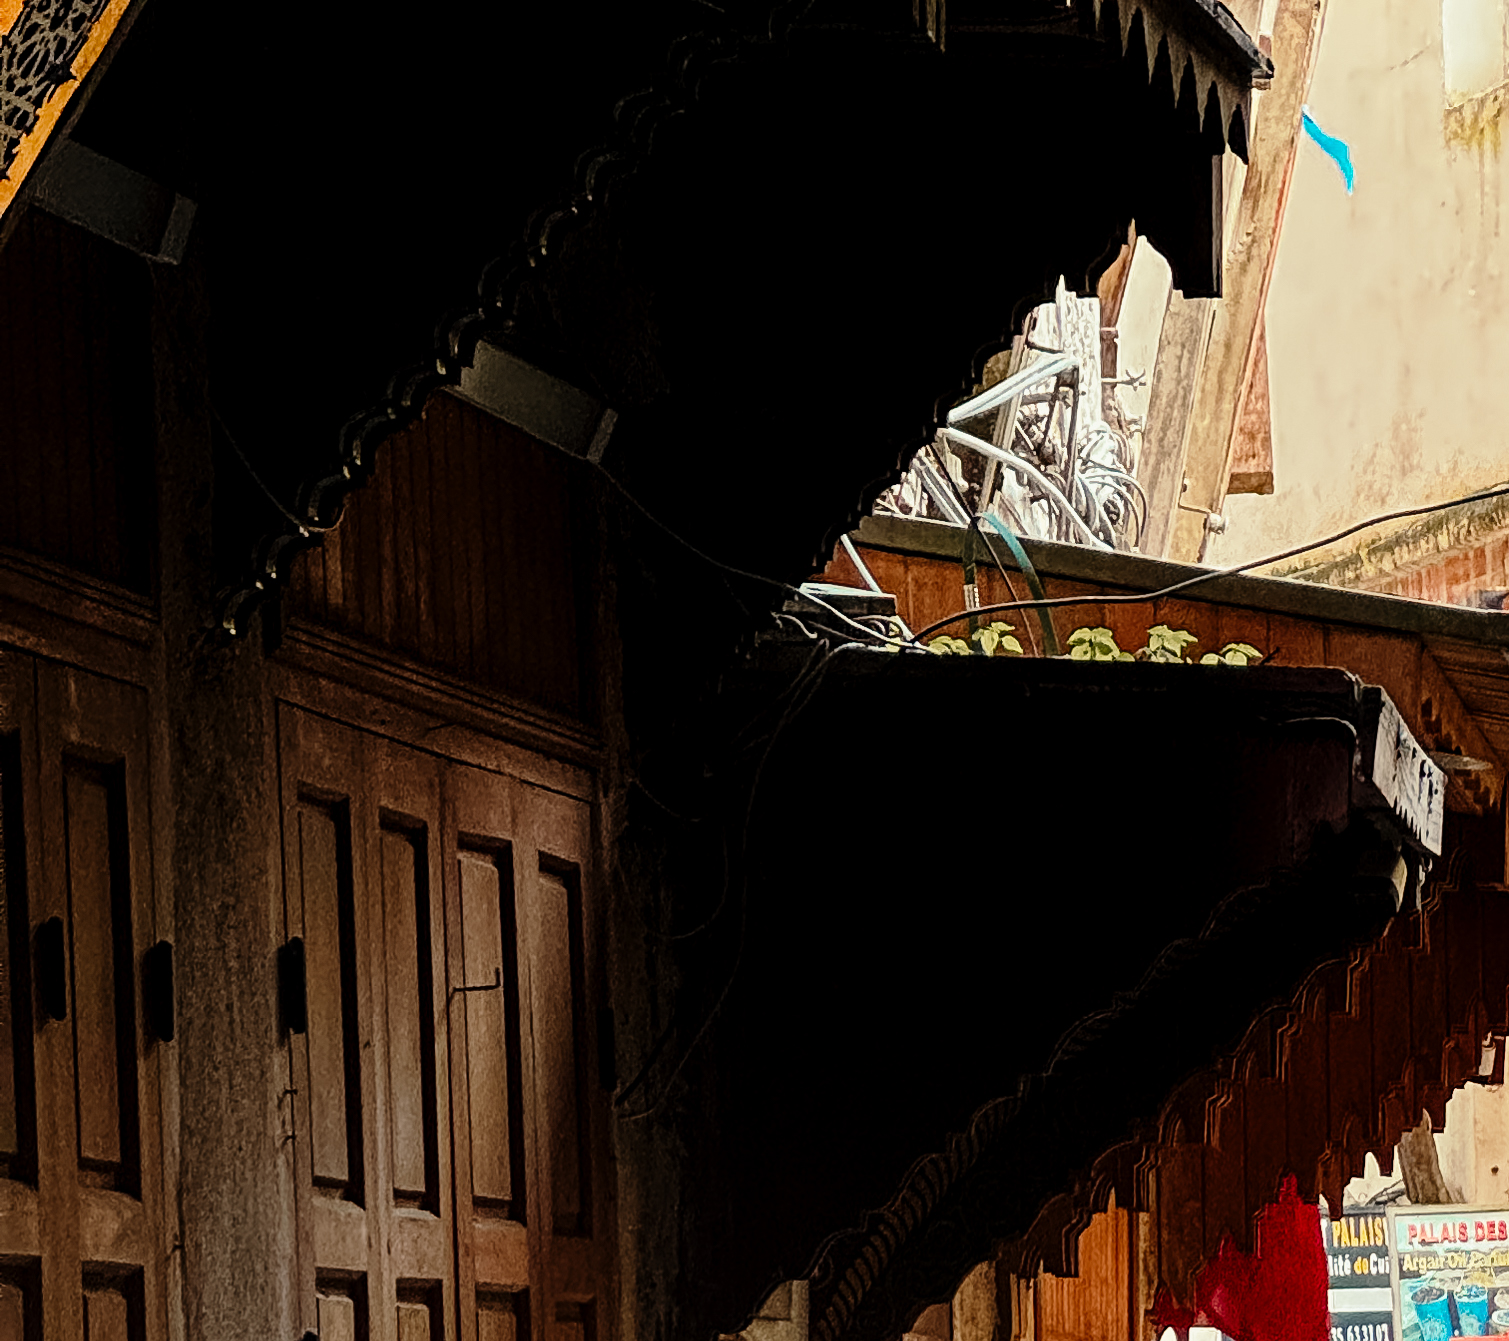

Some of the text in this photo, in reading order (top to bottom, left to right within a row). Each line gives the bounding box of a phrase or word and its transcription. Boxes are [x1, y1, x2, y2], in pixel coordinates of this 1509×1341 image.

[1332, 1216, 1383, 1247] PALAIS
[1408, 1220, 1468, 1244] PALAIS
[1475, 1220, 1508, 1242] DES
